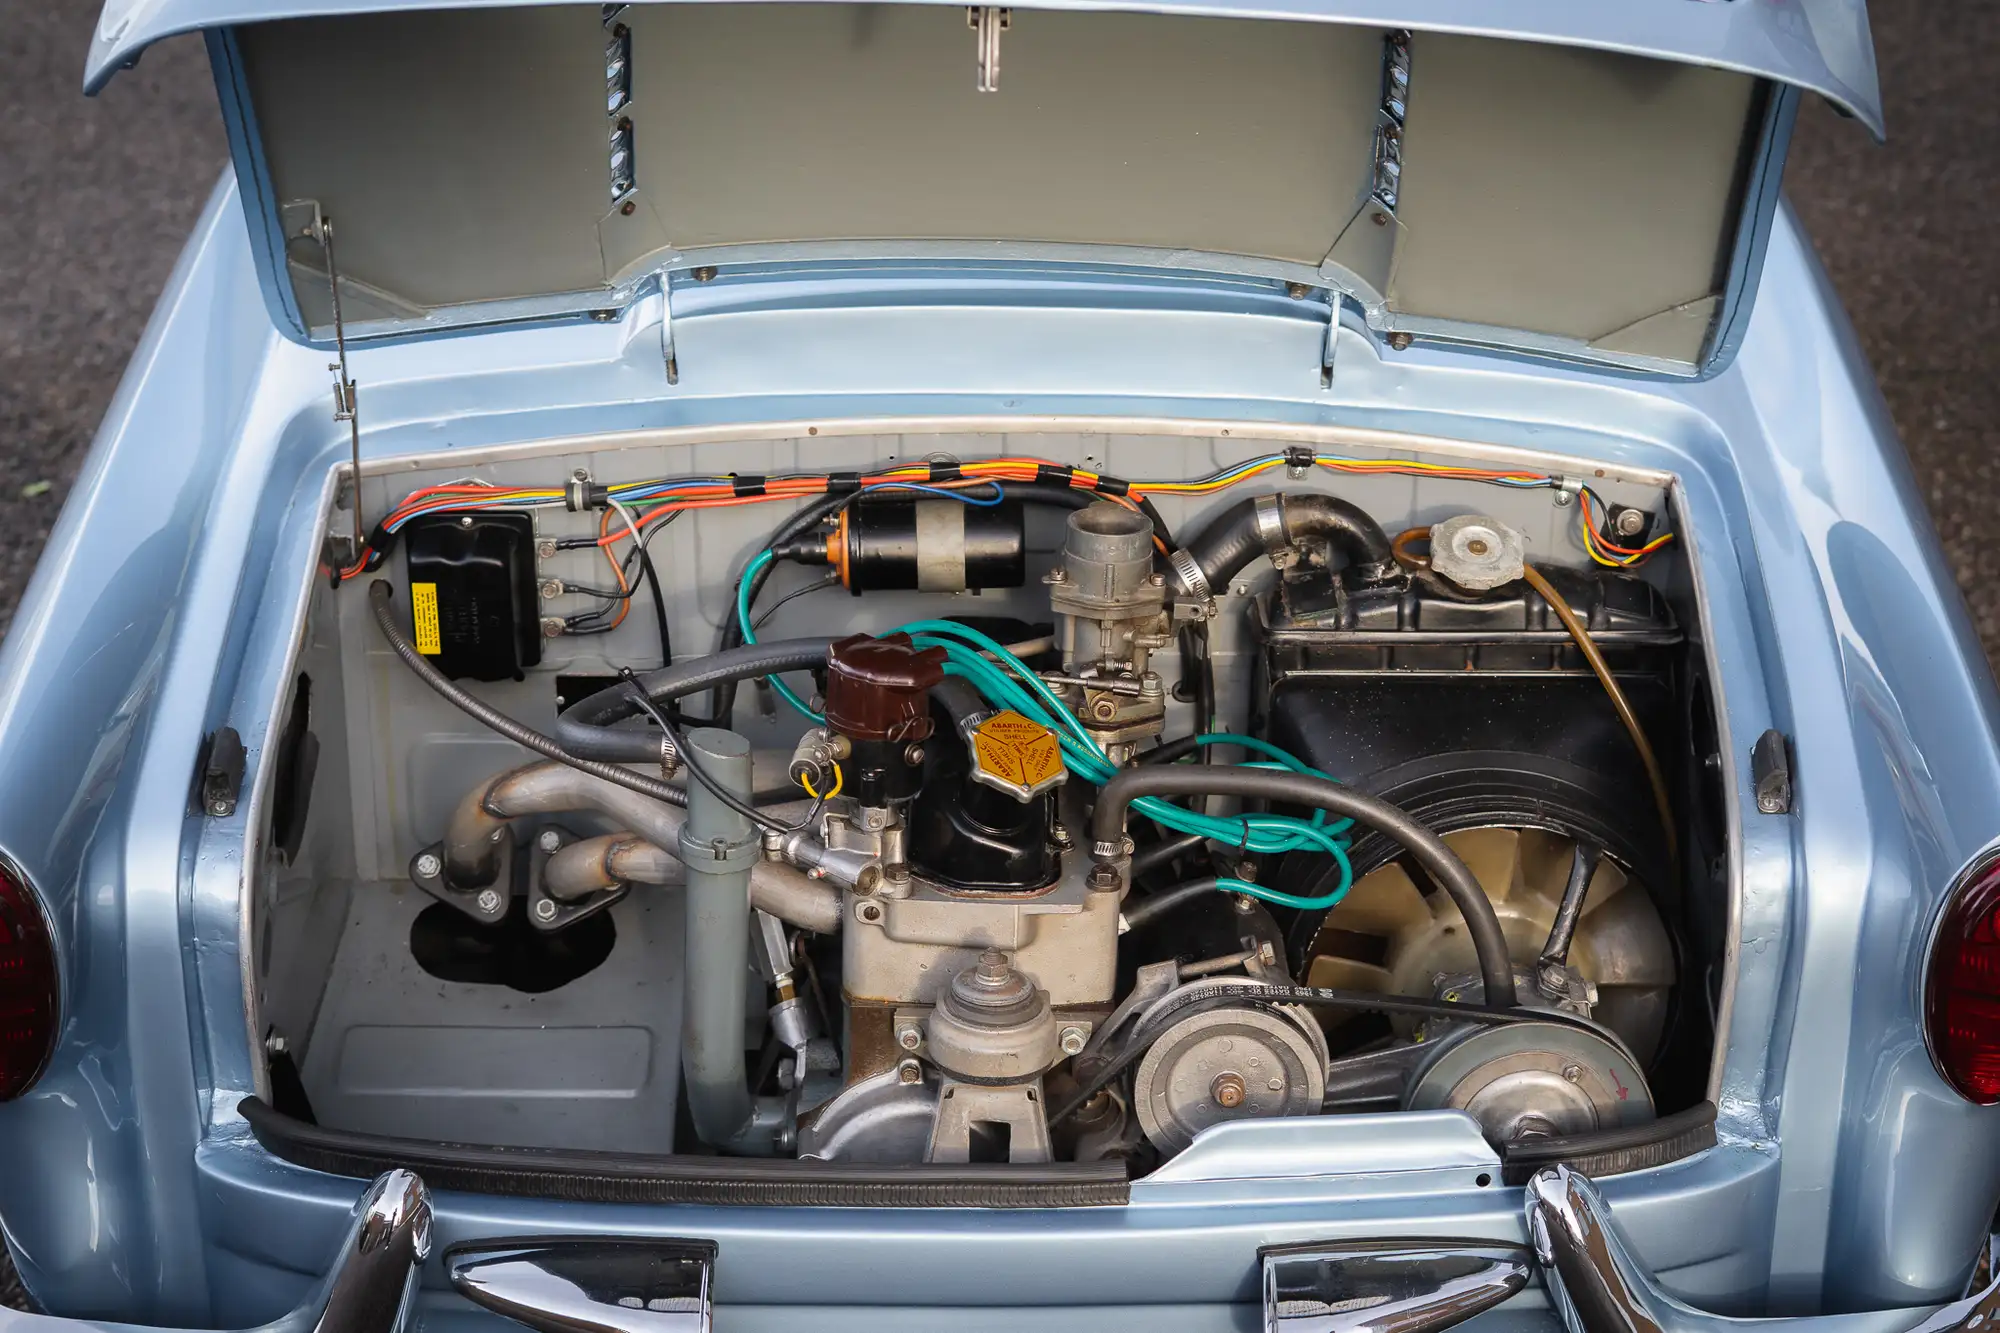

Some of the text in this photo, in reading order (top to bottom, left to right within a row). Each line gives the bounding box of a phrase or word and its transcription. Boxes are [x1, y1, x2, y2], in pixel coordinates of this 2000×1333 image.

[997, 746, 1016, 765] SHELL
[1012, 743, 1025, 757] SHELL
[1026, 747, 1039, 765] SHELL
[1040, 746, 1055, 770] ABARTH
[987, 752, 1012, 777] ABARTH
